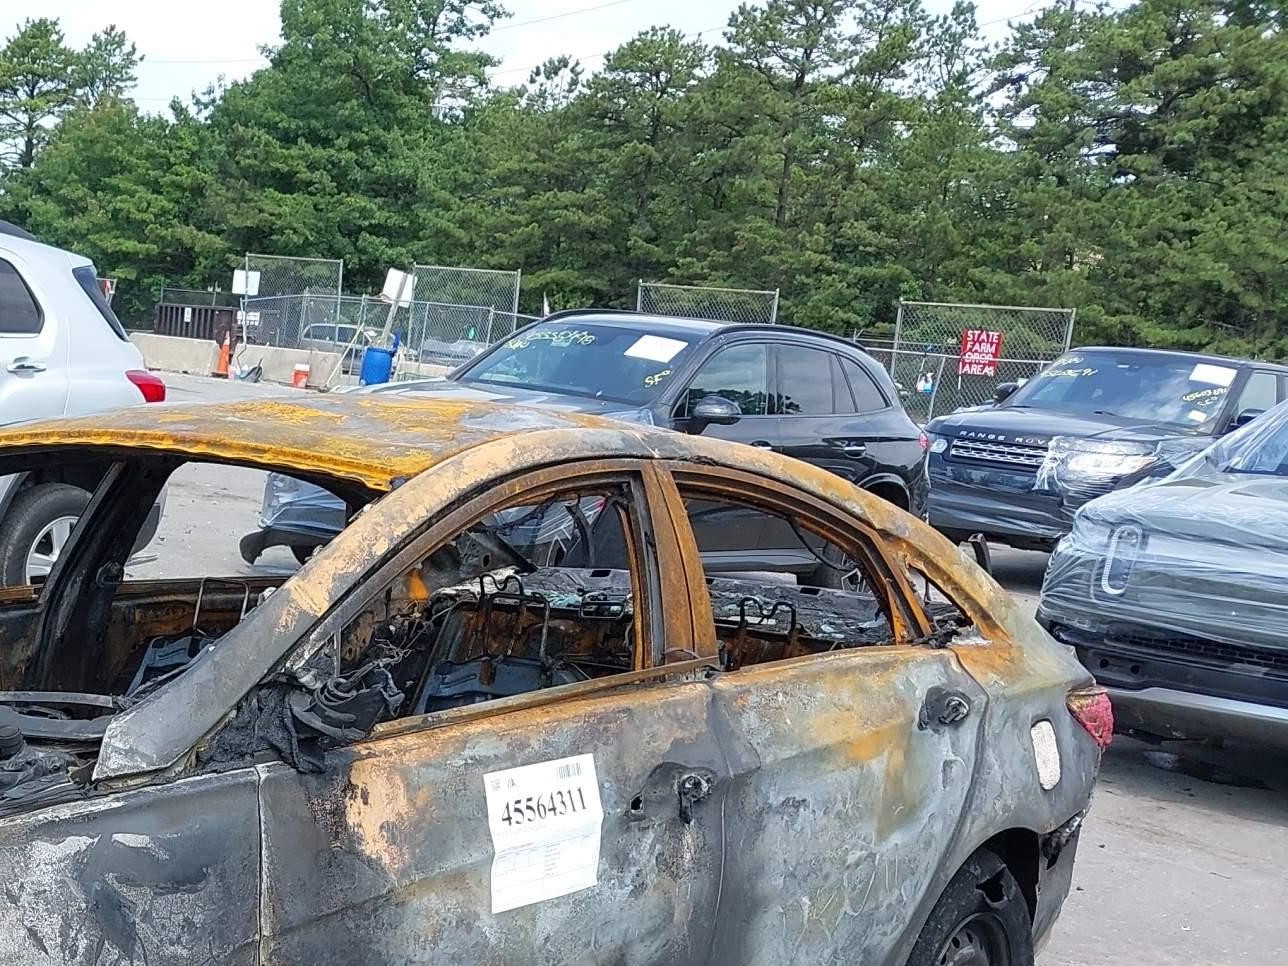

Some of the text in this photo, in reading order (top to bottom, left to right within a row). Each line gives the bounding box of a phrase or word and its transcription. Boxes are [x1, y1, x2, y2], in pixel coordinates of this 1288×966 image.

[966, 330, 1000, 343] STATE
[966, 341, 996, 354] FARM
[964, 351, 994, 364] DROP
[961, 364, 991, 376] AREA
[959, 430, 1006, 441] RANGE
[501, 787, 588, 826] 45564311
